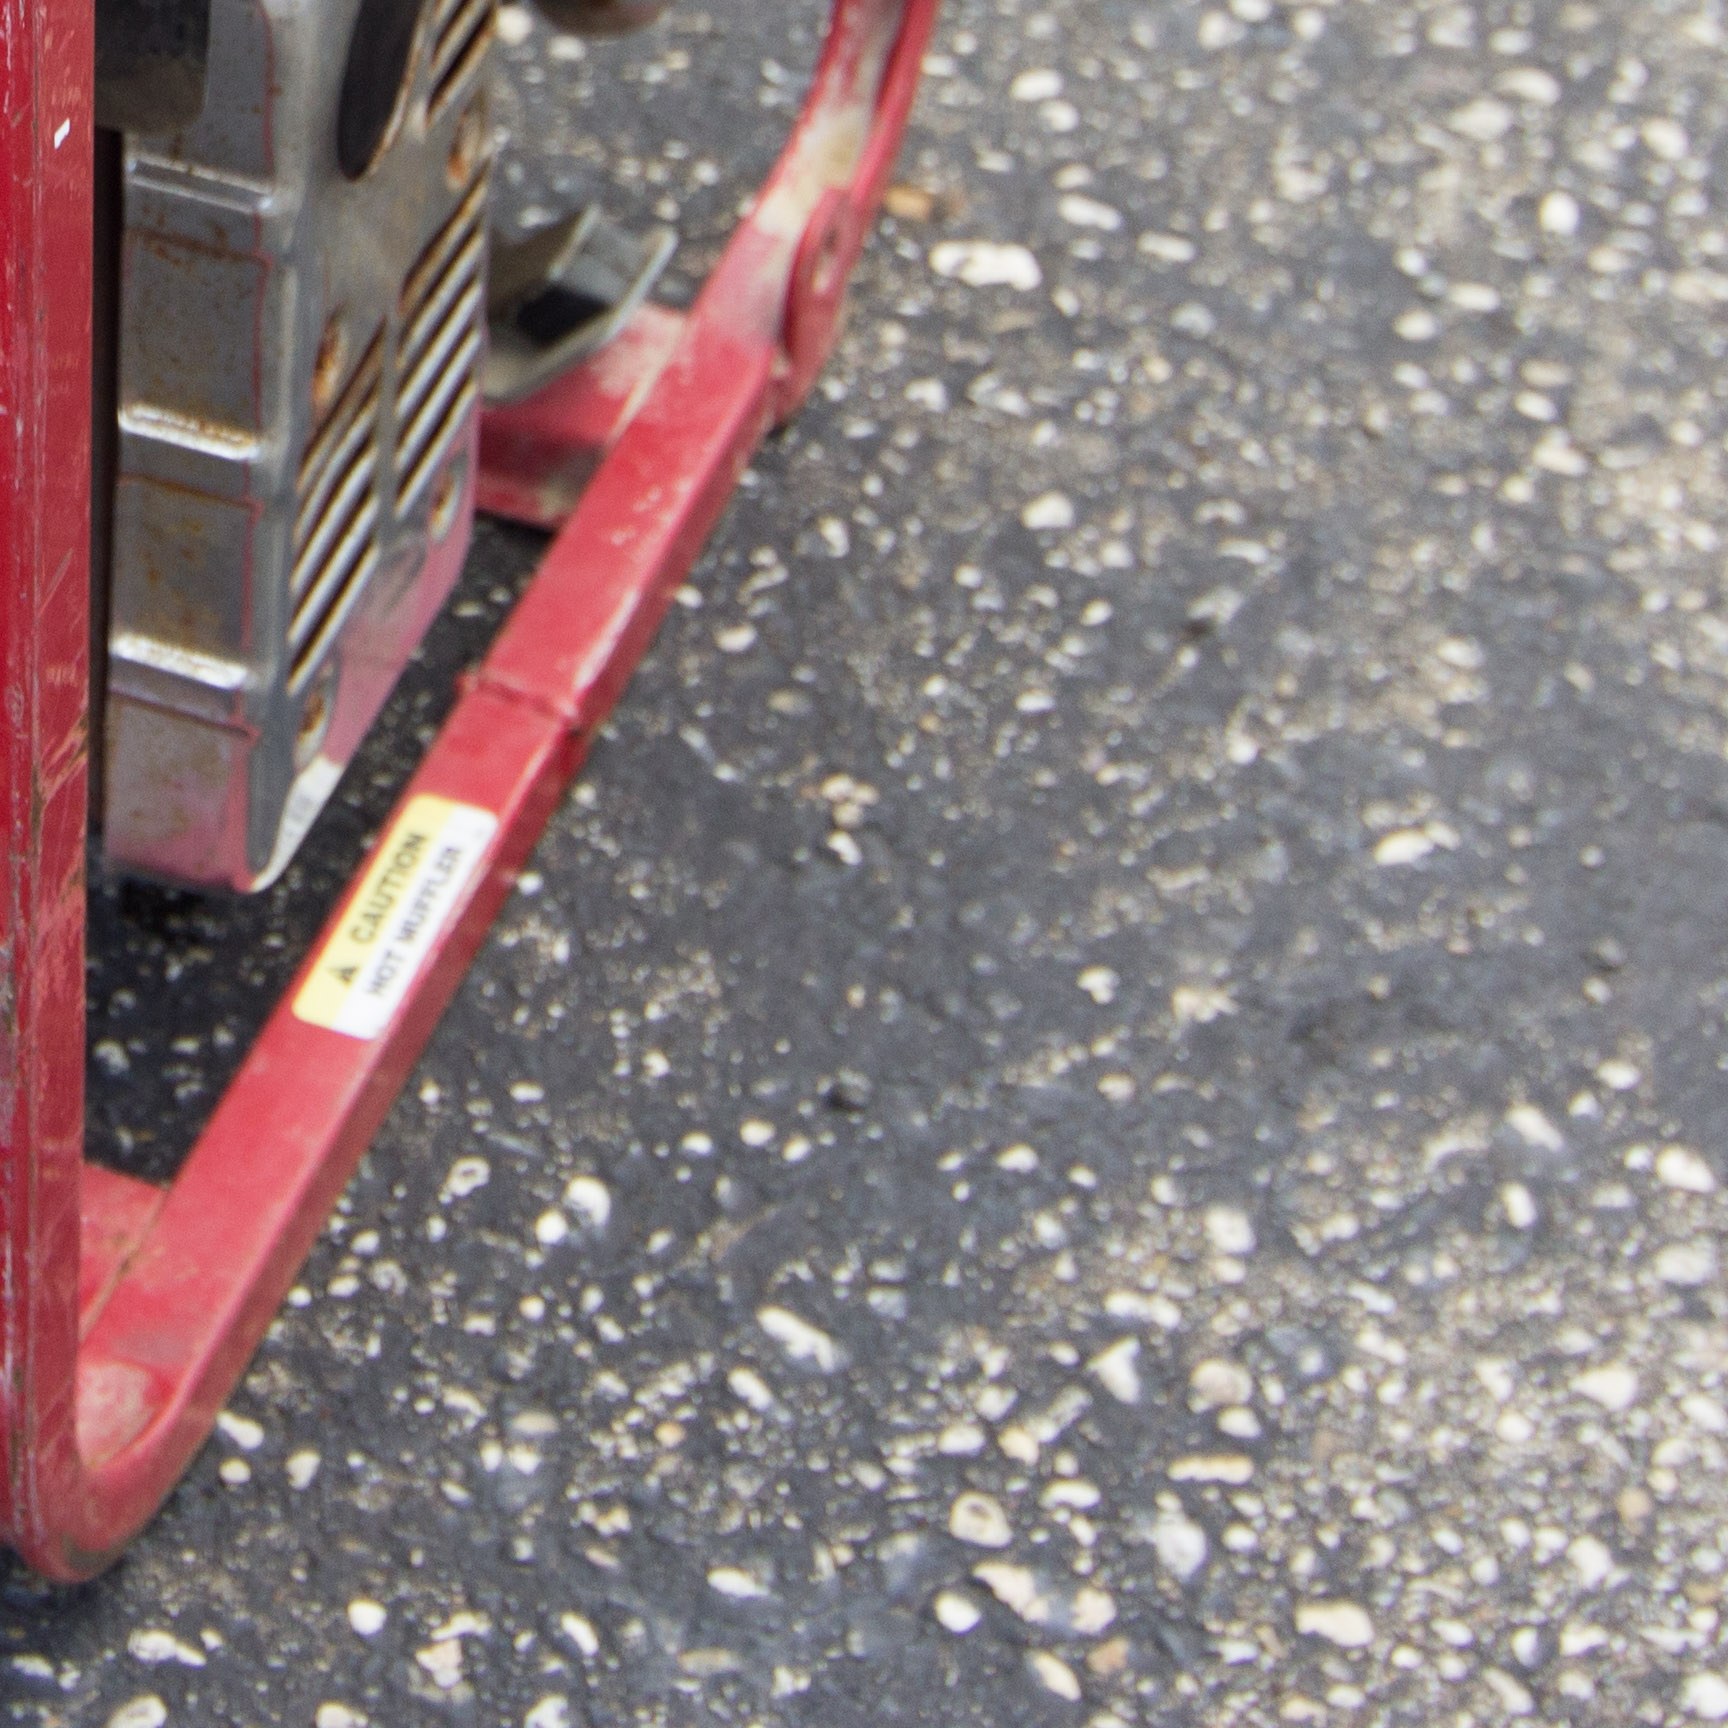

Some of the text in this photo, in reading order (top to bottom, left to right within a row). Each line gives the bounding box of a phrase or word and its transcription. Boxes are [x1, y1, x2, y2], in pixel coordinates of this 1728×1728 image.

[350, 833, 426, 943] CAUTION
[368, 846, 461, 997] HOT MUFFLER
